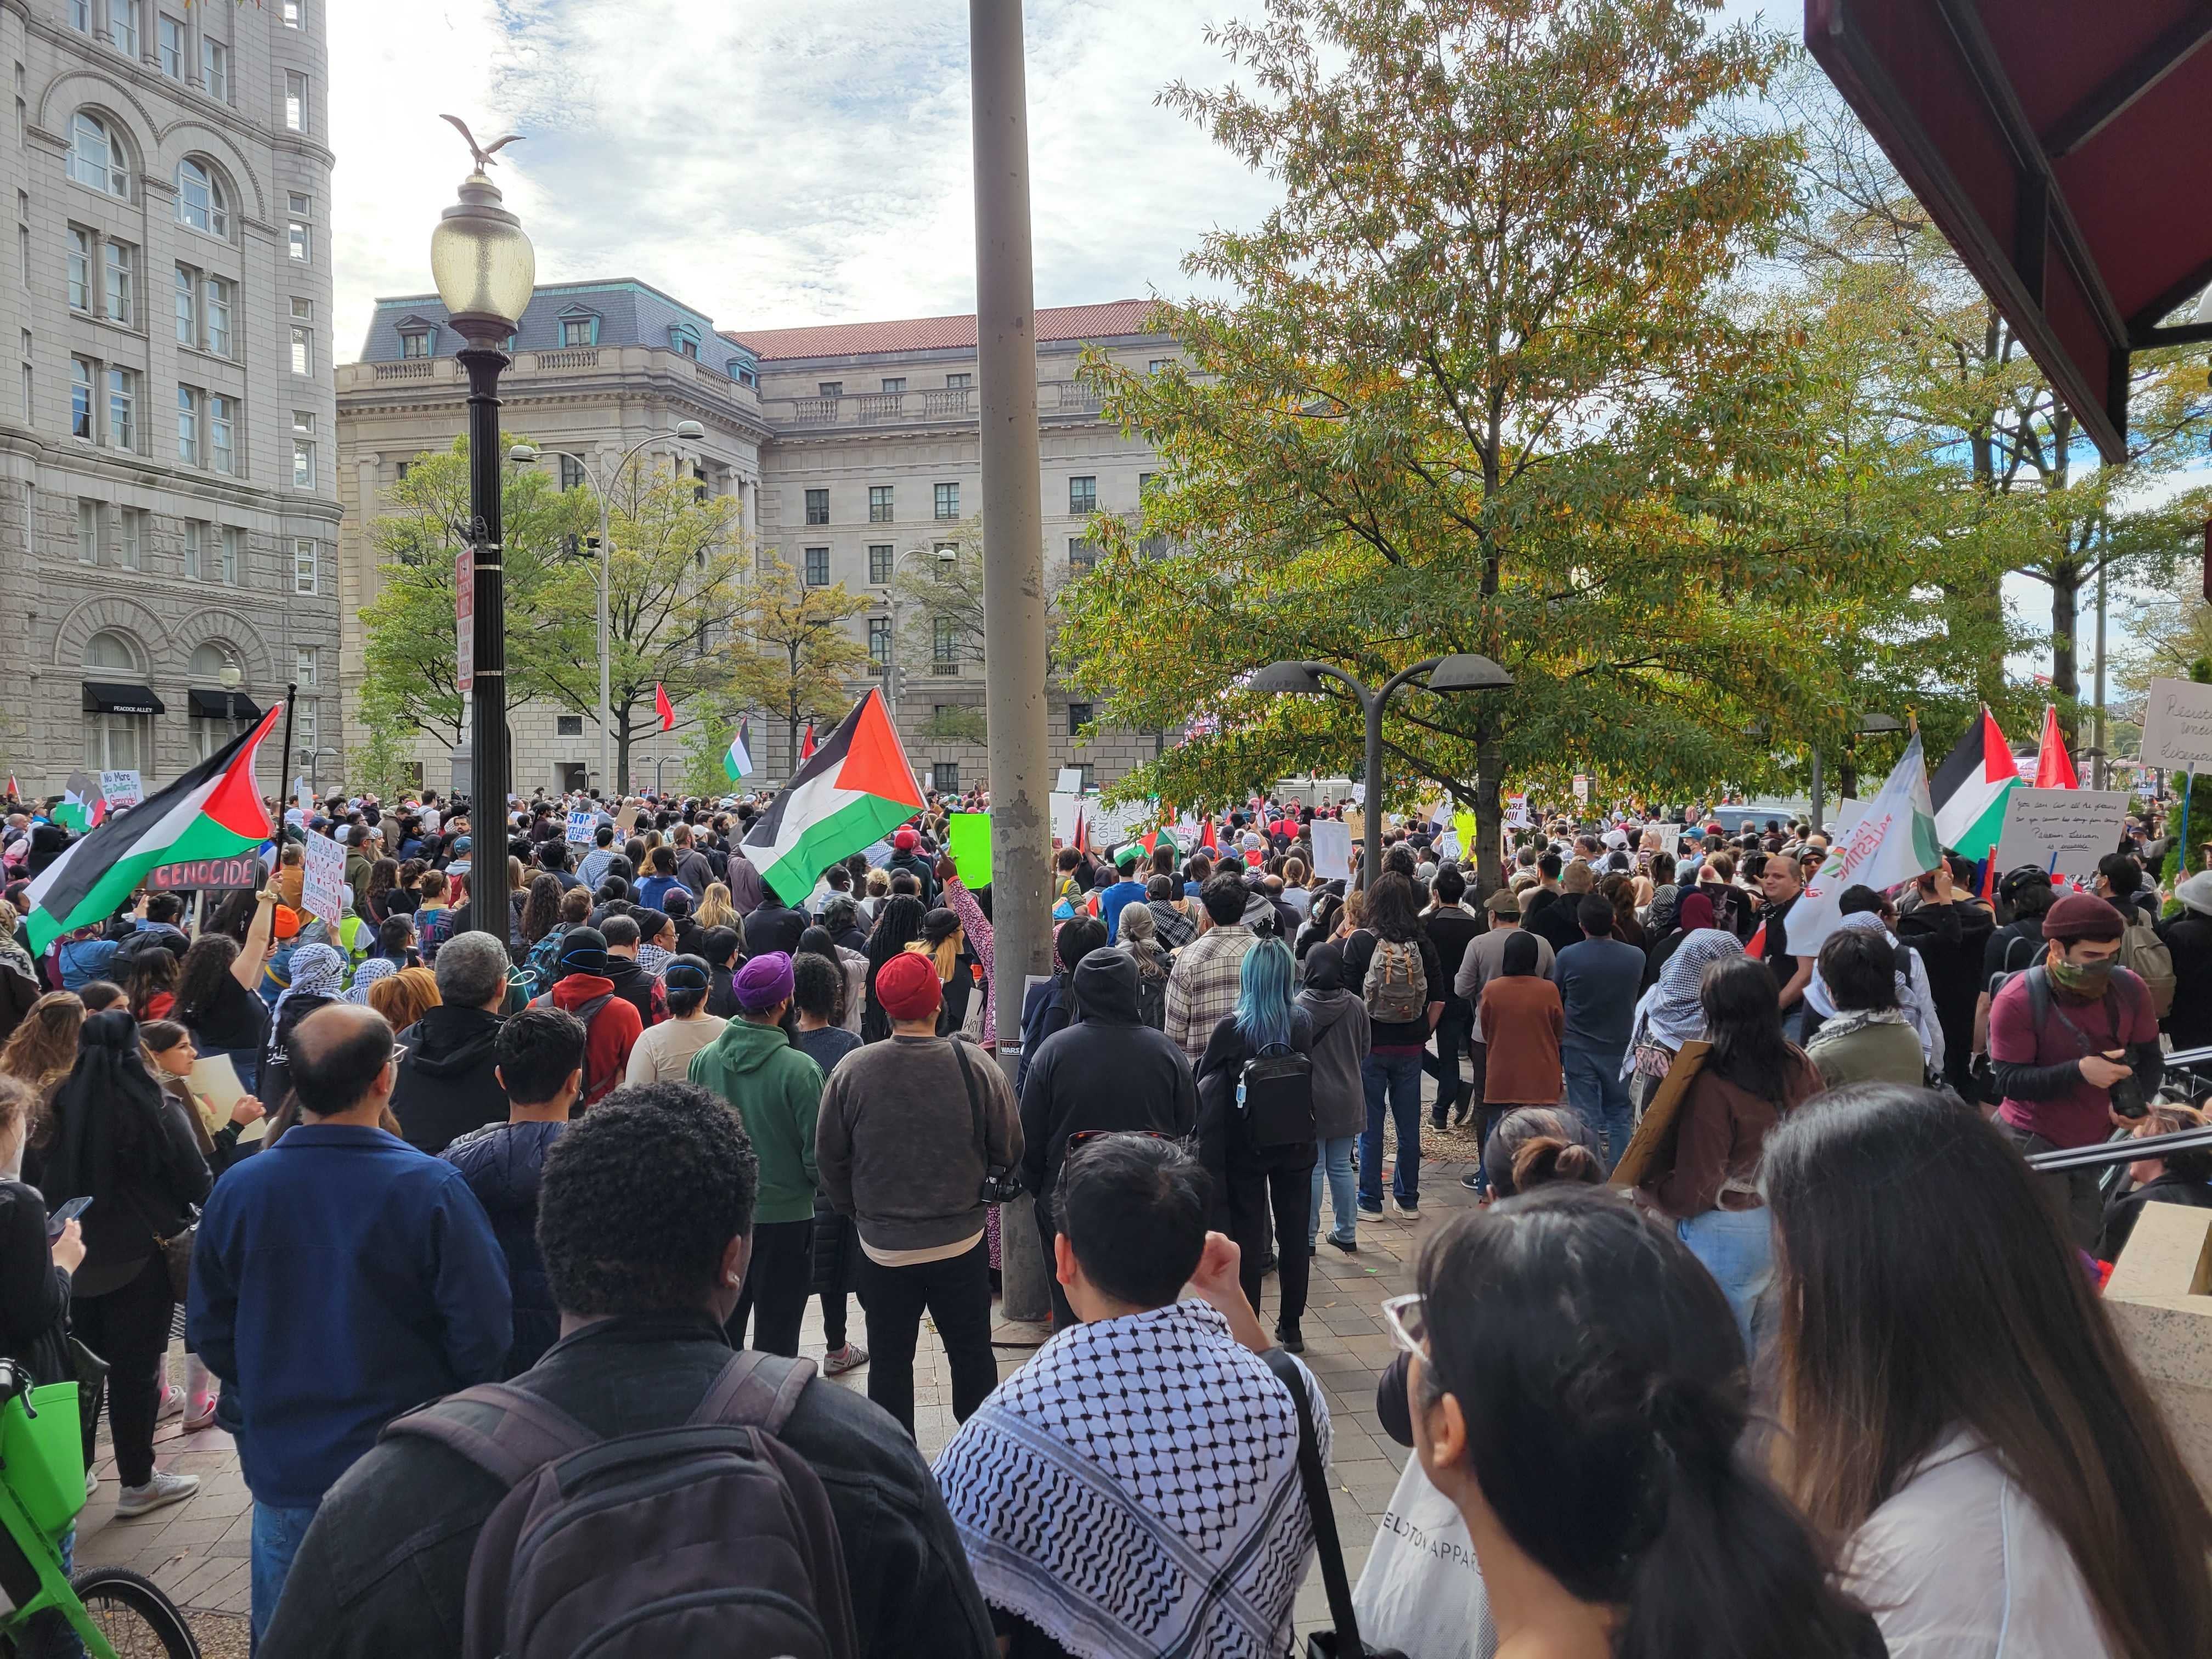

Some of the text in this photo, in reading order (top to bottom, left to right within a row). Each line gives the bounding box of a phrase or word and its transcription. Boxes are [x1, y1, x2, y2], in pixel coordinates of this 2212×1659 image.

[104, 772, 131, 783] No More
[567, 812, 590, 826] STOP
[155, 859, 252, 888] GENOCIDE
